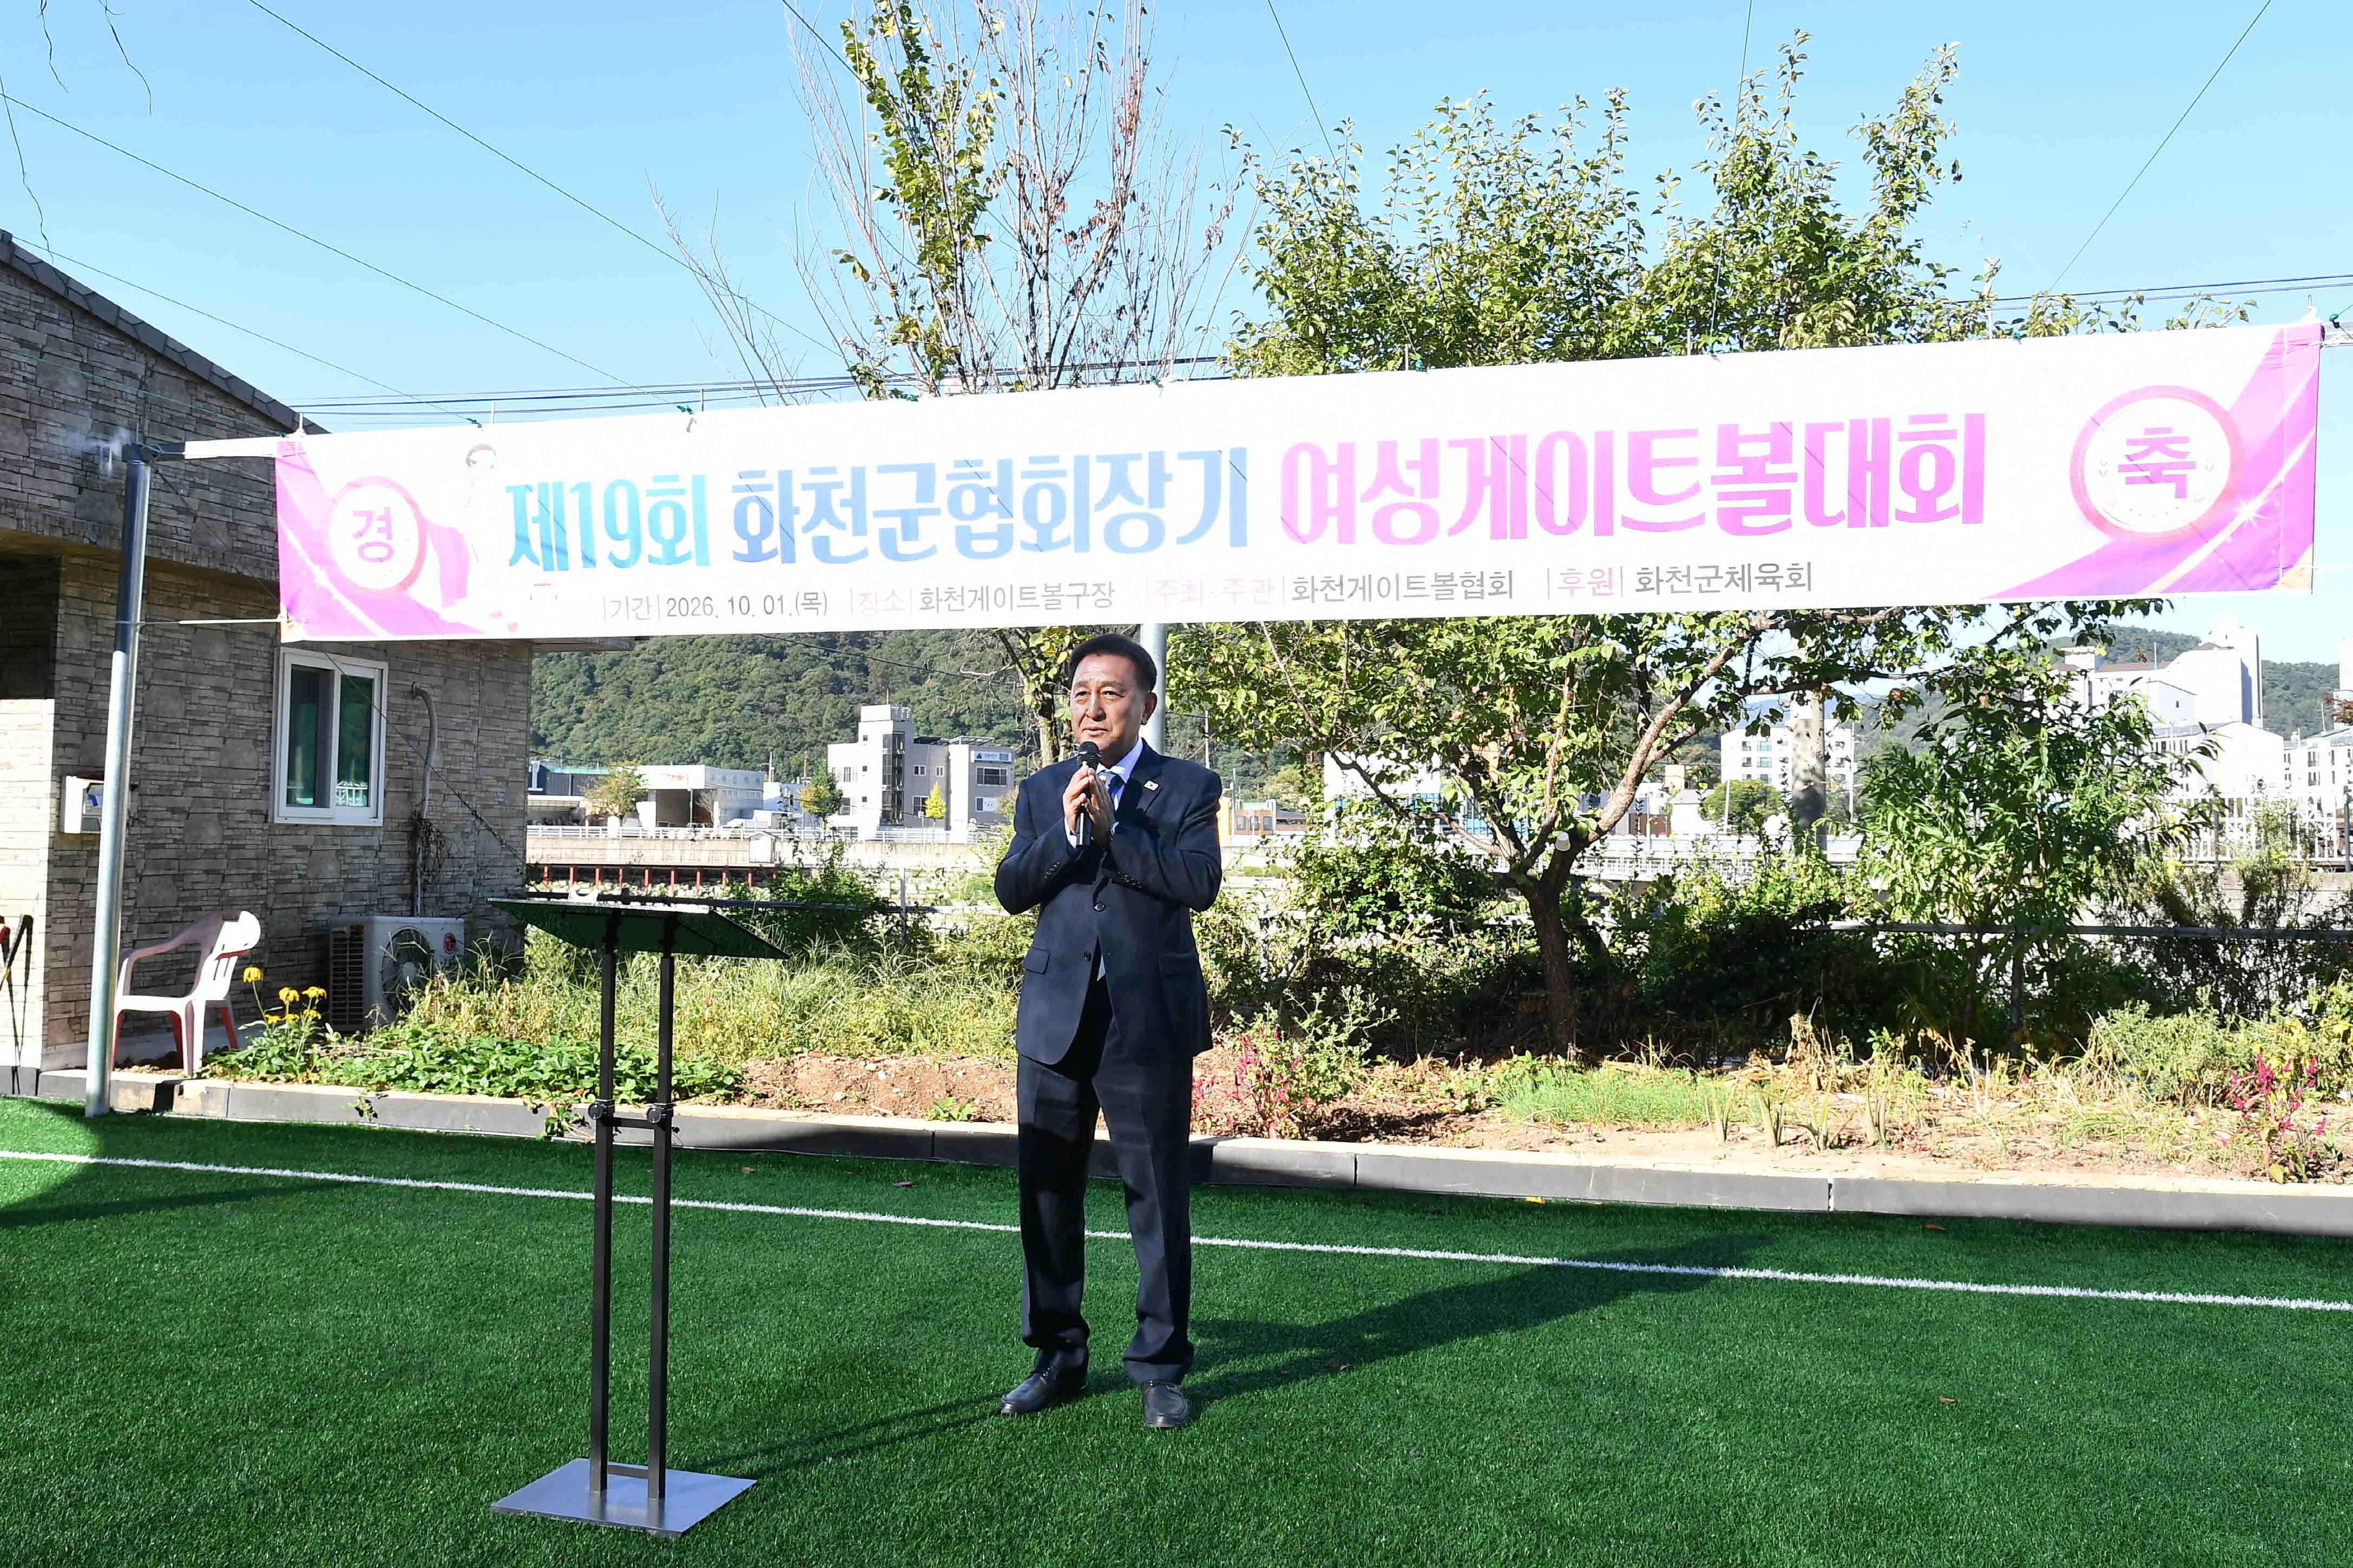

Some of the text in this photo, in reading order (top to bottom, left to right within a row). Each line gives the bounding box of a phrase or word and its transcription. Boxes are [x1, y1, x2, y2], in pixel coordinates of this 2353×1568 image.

[504, 412, 1987, 572] 제19회 화천군협회장기 여성게이트볼대회
[2117, 426, 2197, 499] 축
[352, 506, 395, 563] 경
[610, 596, 653, 621] 기간
[666, 596, 719, 619] 2026.
[727, 595, 755, 618] 10.
[858, 590, 905, 617] 장소
[918, 581, 1116, 614] 화천게이트볼구장
[1292, 569, 1514, 604] 화천게이트볼협회
[1557, 567, 1615, 598] 후원
[1634, 561, 1812, 596] 화천군체육회
